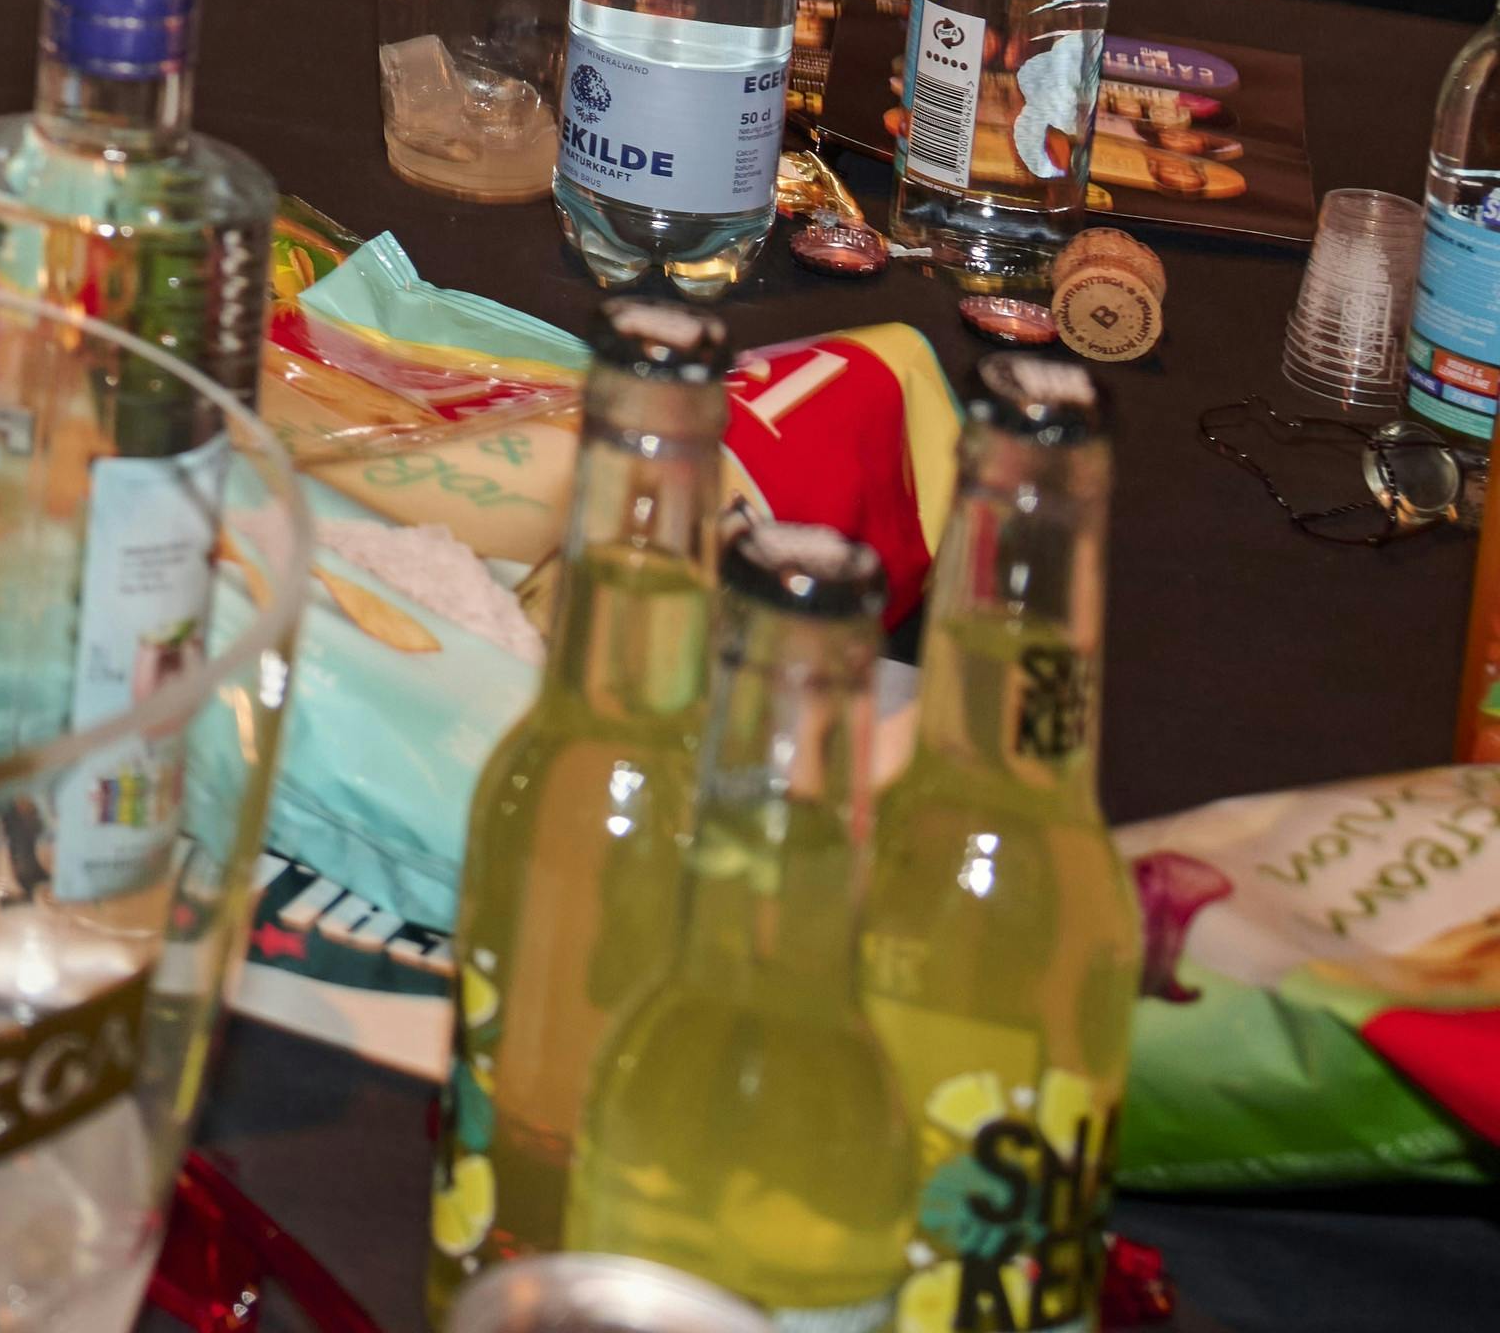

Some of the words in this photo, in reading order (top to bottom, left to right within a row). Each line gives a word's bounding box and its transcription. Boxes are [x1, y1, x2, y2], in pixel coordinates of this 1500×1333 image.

[587, 47, 649, 76] MINERALVAND
[740, 110, 758, 125] 50
[761, 107, 771, 122] cl
[560, 114, 675, 178] EKILDE
[564, 146, 633, 183] NATURKRAFT
[1075, 276, 1124, 291] BOTTEGA
[1090, 305, 1119, 330] B
[1087, 338, 1137, 355] BOTTEGA
